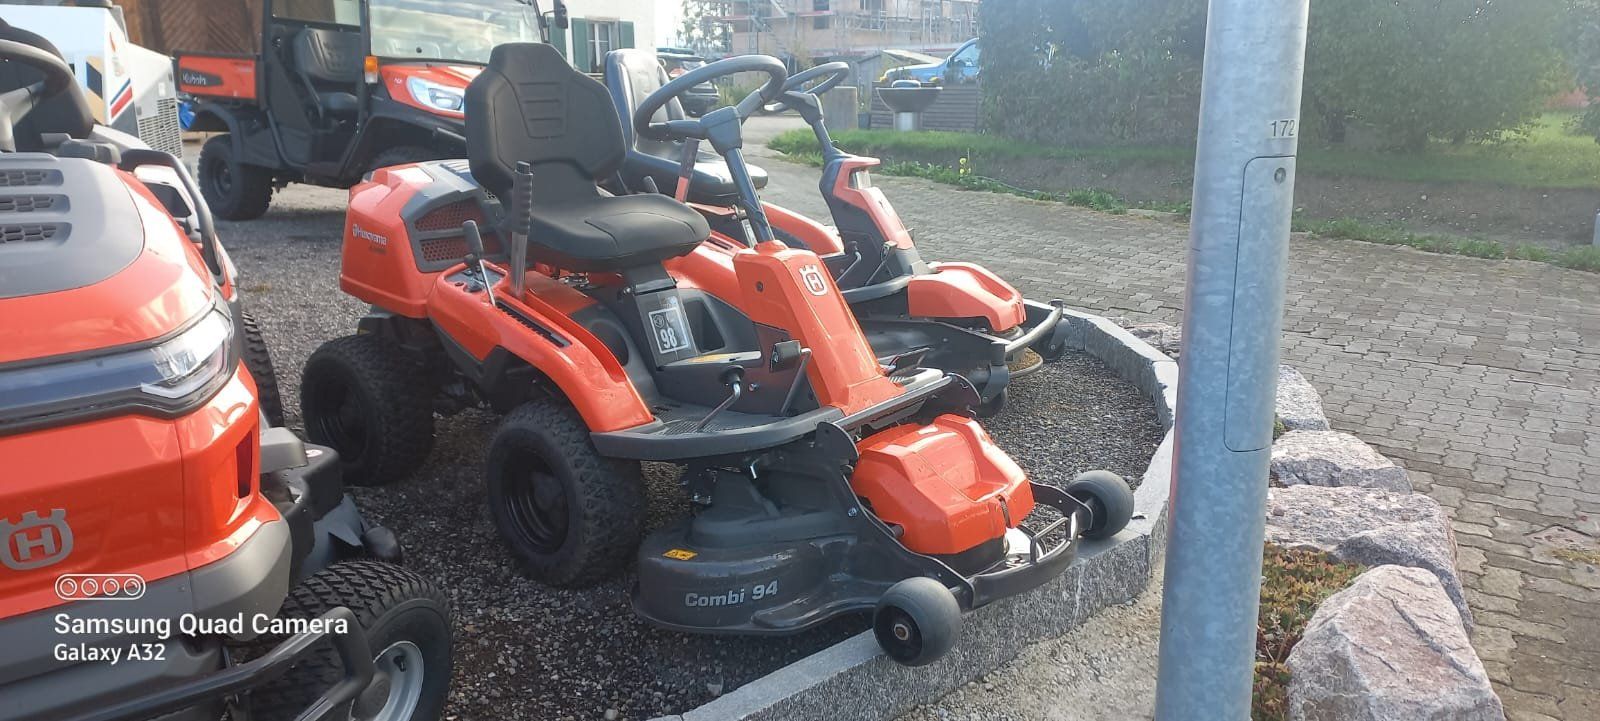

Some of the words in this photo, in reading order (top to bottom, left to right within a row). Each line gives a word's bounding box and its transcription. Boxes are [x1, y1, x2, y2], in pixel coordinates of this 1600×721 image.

[1271, 119, 1295, 137] 172
[660, 327, 678, 349] 98
[684, 588, 745, 607] Combi
[751, 579, 778, 600] 94
